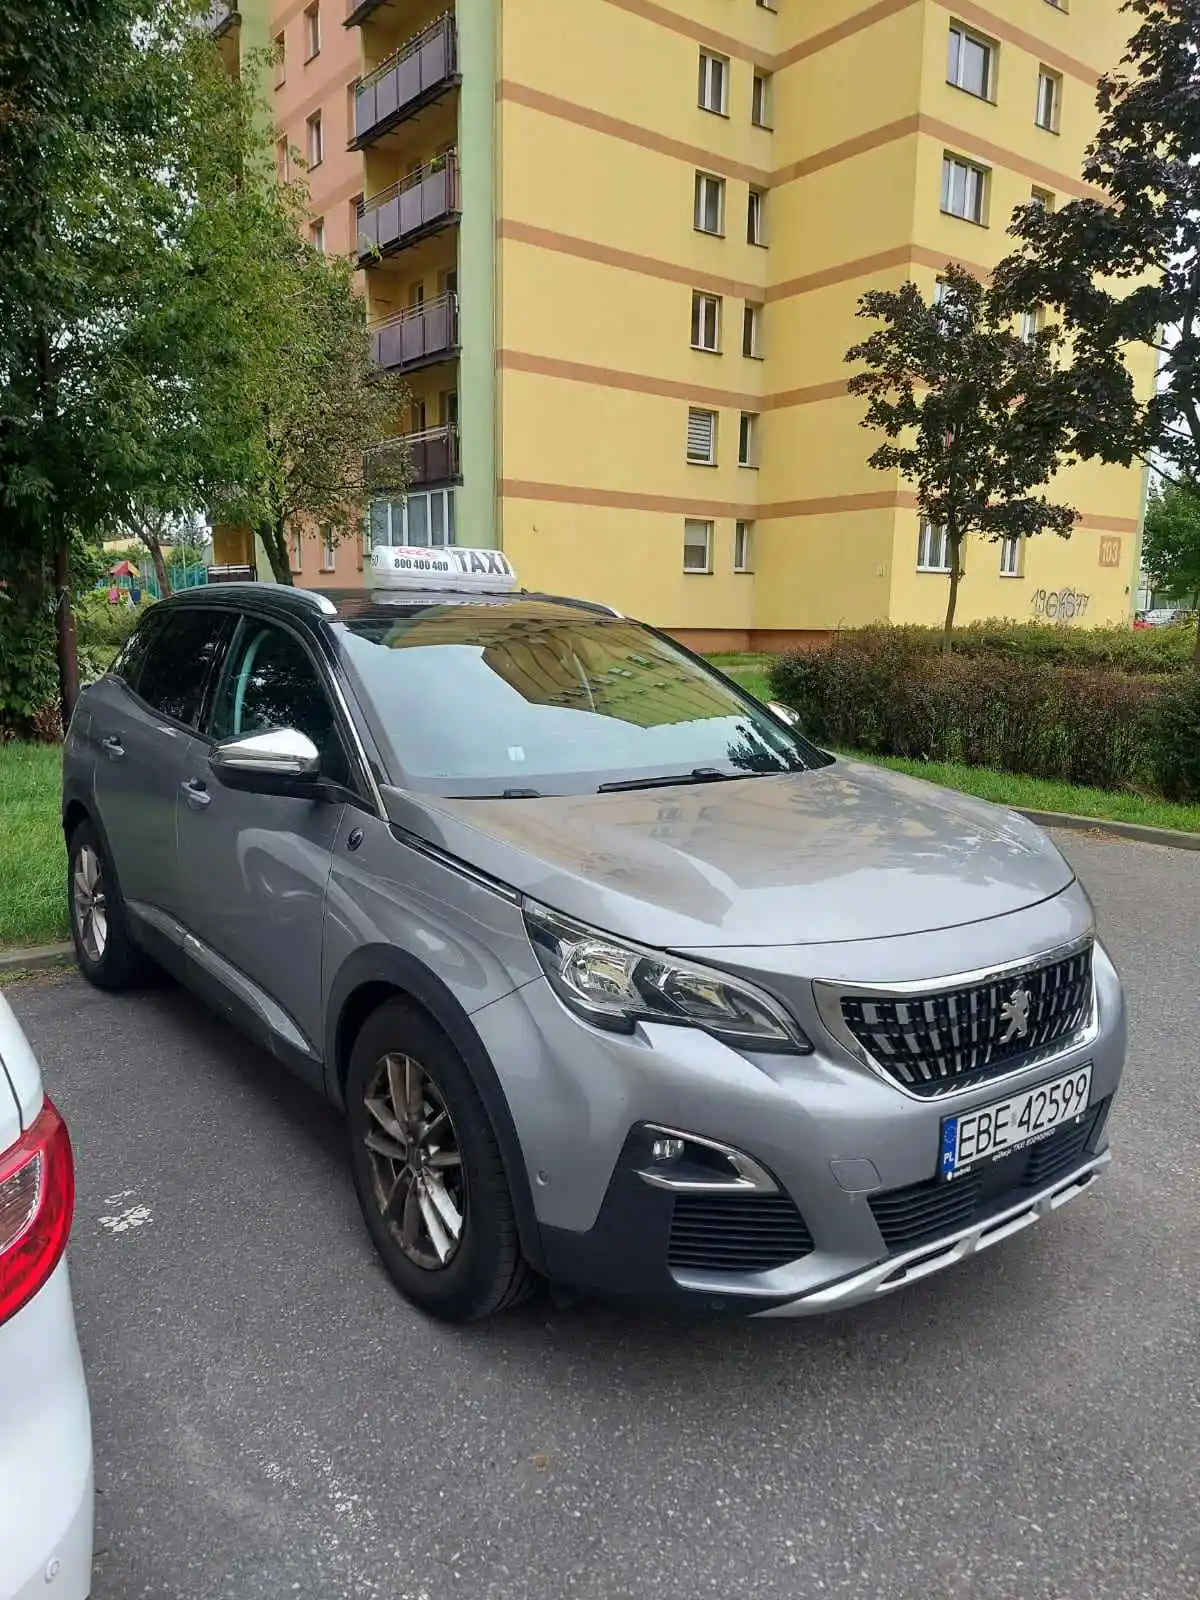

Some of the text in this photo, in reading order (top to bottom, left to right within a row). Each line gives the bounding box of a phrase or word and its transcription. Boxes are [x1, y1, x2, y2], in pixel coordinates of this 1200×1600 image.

[394, 558, 412, 569] 800
[413, 559, 431, 570] 400
[451, 551, 511, 575] TAXI
[958, 1072, 1087, 1161] EBE 42599
[943, 1152, 955, 1164] PL
